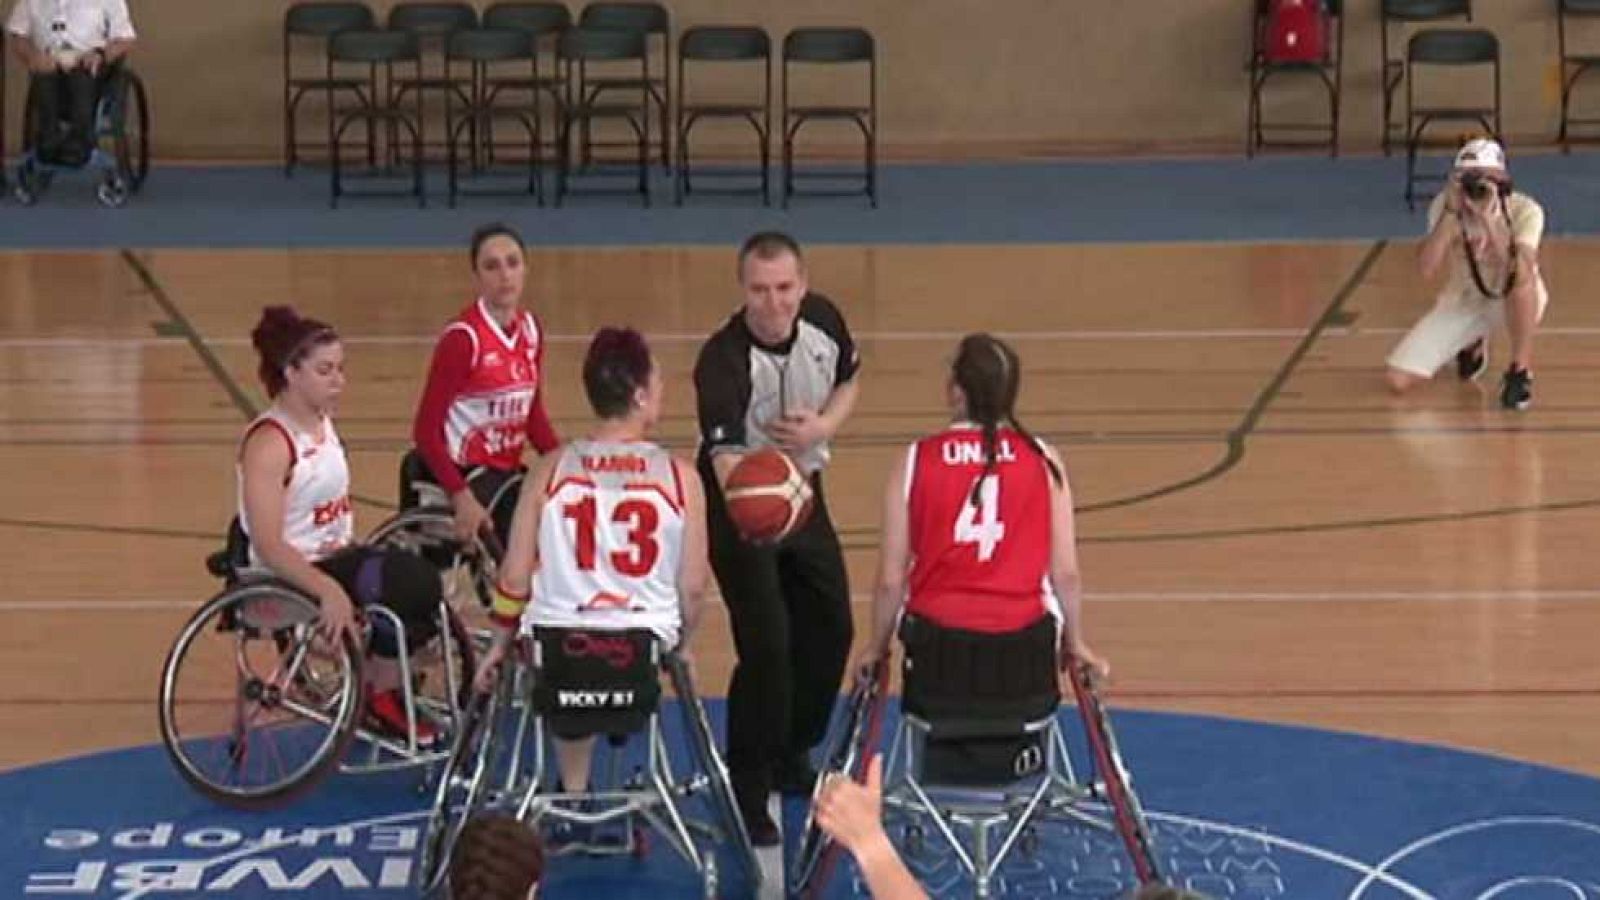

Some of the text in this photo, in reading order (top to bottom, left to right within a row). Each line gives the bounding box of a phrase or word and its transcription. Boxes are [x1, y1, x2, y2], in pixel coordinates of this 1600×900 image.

[562, 493, 660, 579] 13
[953, 474, 1005, 562] 4
[43, 822, 419, 850] Europe
[25, 857, 414, 893] IWBF
